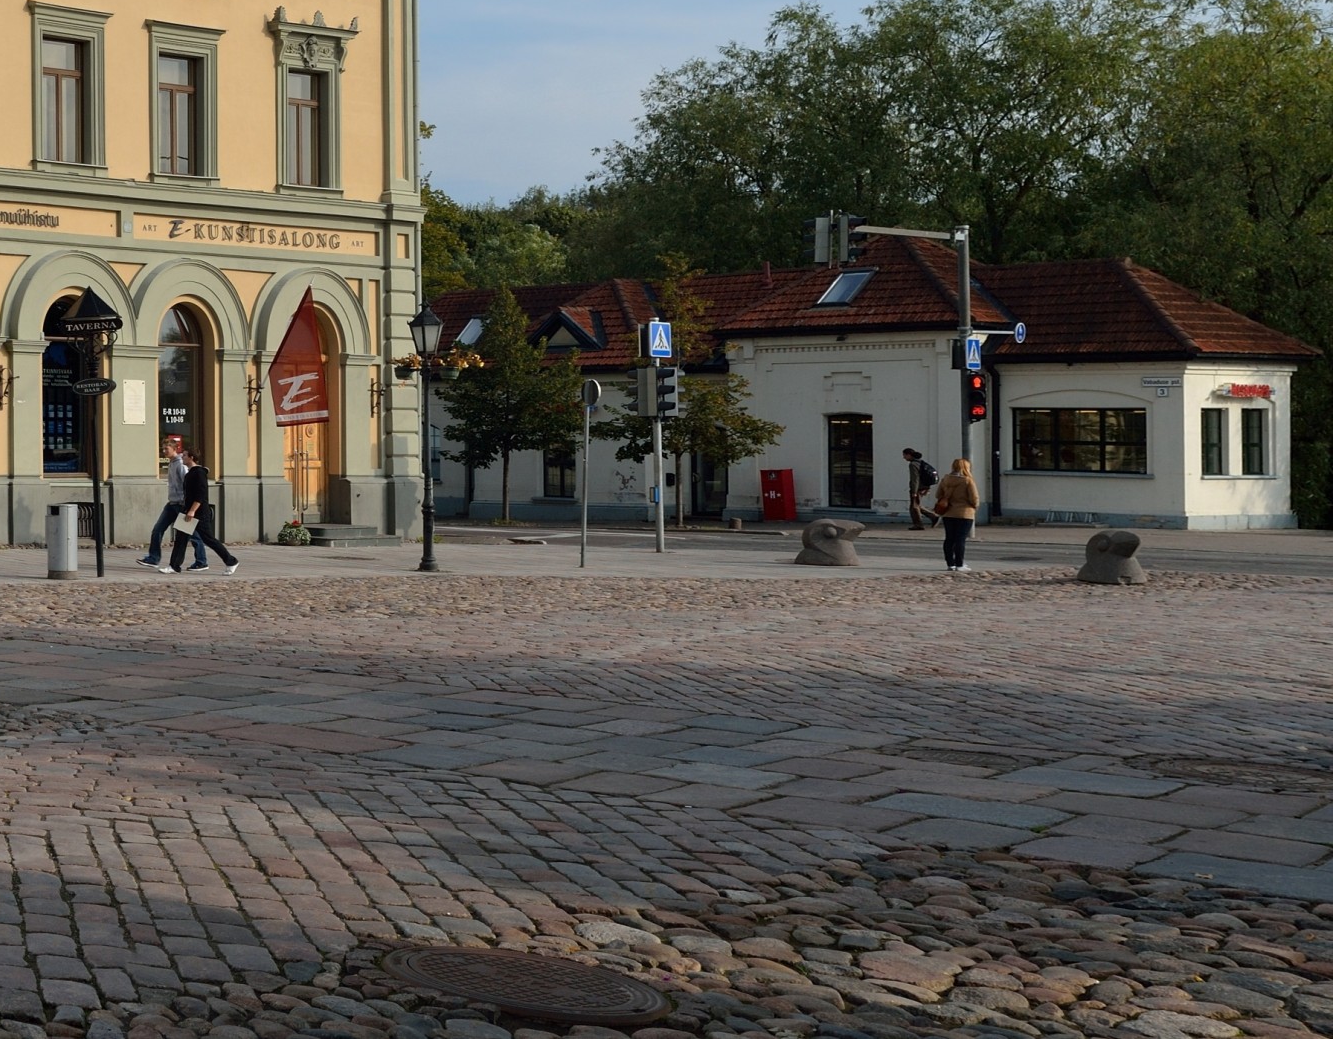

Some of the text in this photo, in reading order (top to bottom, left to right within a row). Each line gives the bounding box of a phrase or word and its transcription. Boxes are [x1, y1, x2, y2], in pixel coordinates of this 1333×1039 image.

[142, 224, 157, 233] ART
[351, 240, 364, 248] ART
[65, 321, 117, 332] TAVERNA
